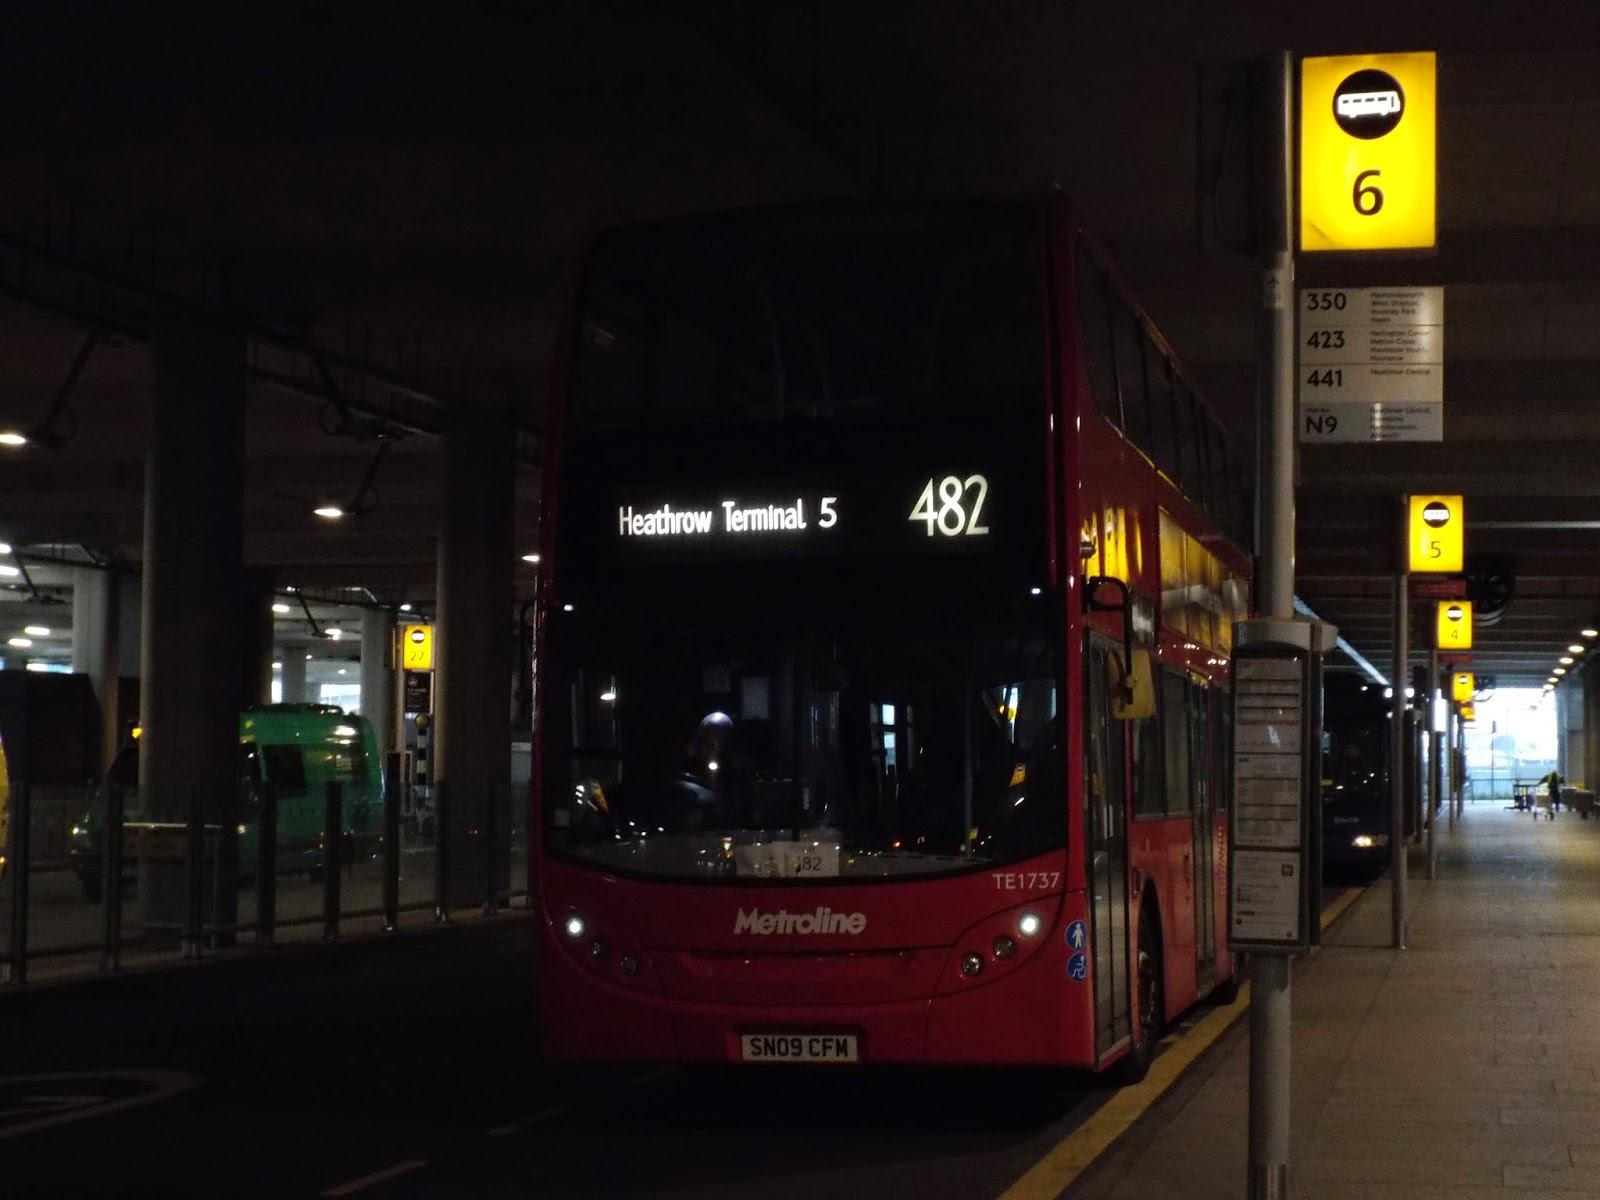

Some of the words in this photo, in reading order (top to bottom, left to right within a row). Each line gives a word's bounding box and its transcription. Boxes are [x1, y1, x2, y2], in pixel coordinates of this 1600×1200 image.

[1352, 169, 1384, 216] 6
[1307, 293, 1347, 310] 350
[1307, 331, 1345, 348] 423
[1307, 369, 1343, 387] 441
[1306, 416, 1338, 433] N9
[908, 474, 990, 537] 482
[619, 504, 712, 536] Heathrow
[721, 498, 807, 532] Terminal
[818, 496, 838, 528] 5
[1431, 541, 1442, 558] 5
[1451, 629, 1459, 640] 4
[411, 651, 425, 661] 27
[992, 872, 1061, 890] TE1737
[734, 906, 867, 936] Metroline
[750, 1037, 802, 1057] SN09
[809, 1037, 849, 1057] CFM
